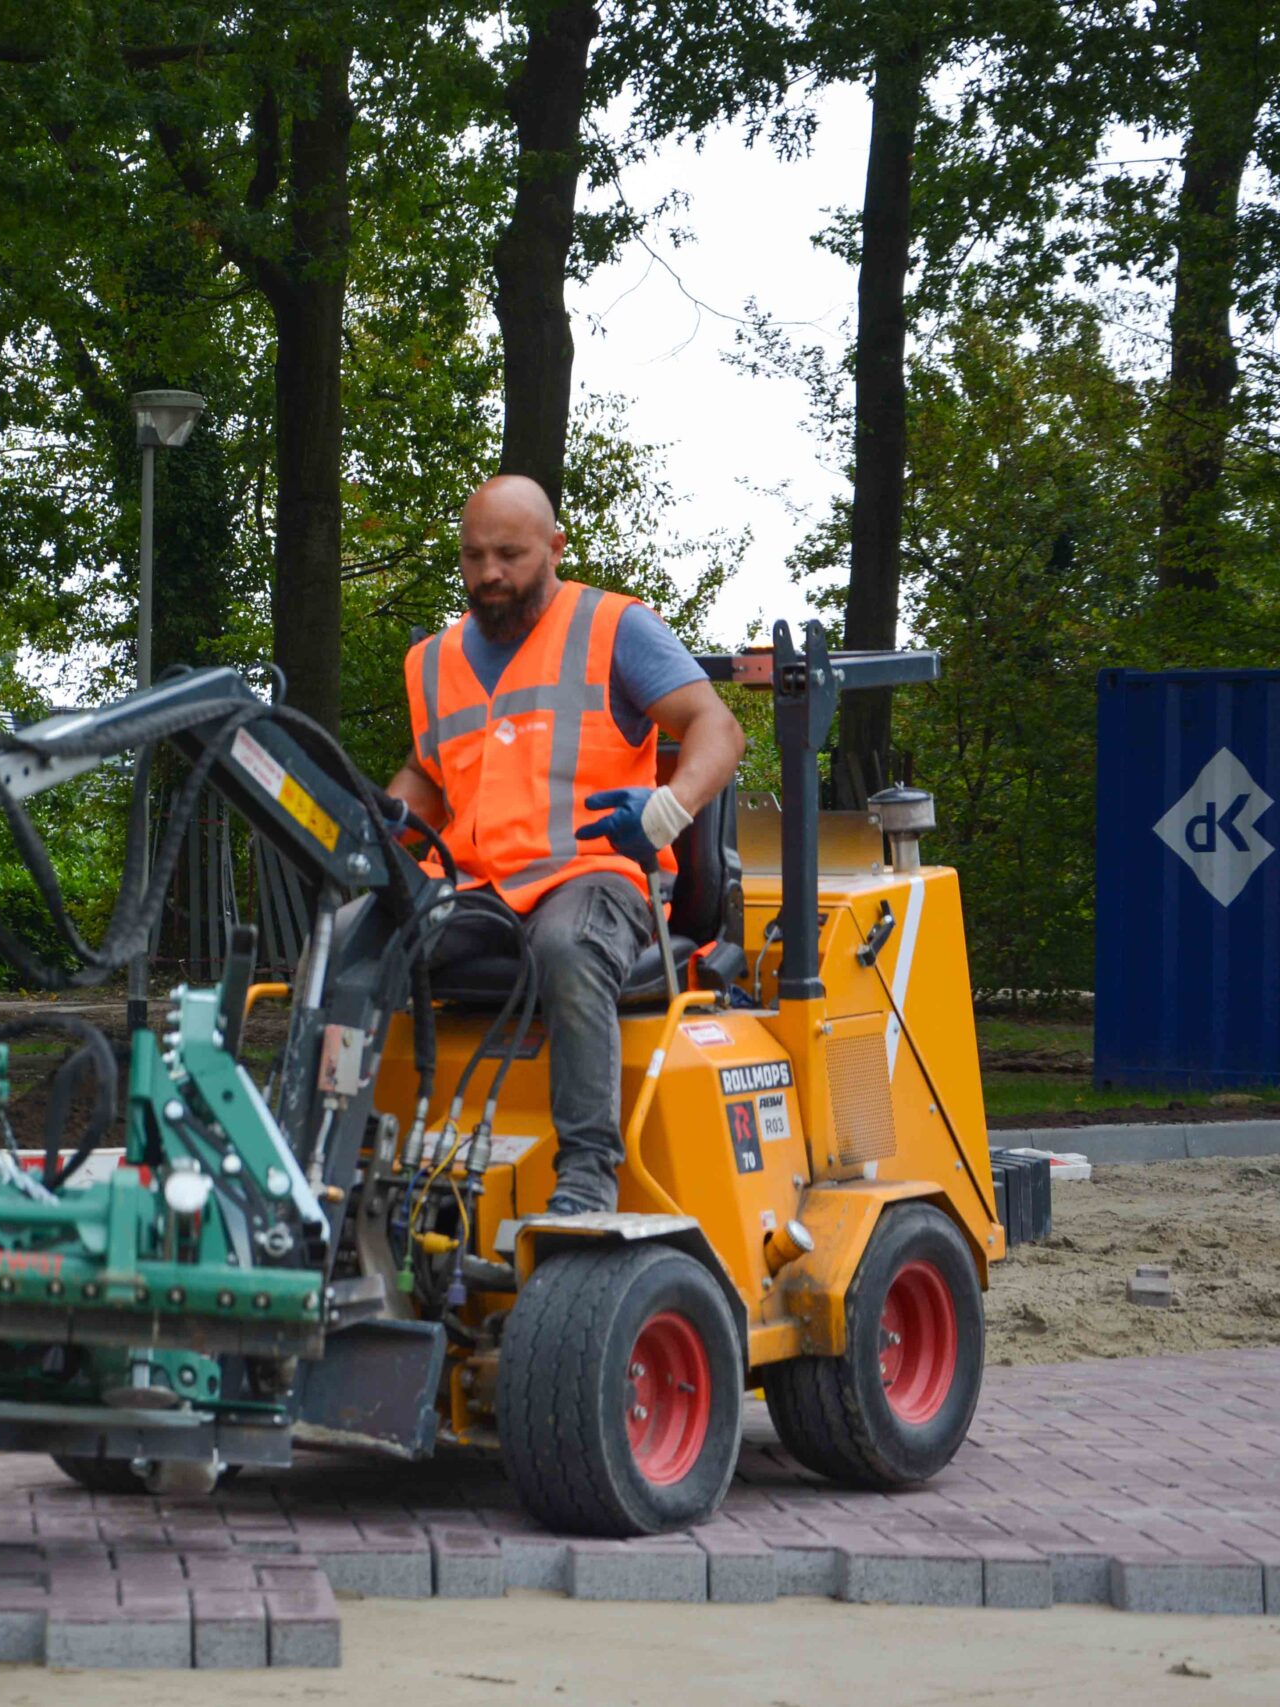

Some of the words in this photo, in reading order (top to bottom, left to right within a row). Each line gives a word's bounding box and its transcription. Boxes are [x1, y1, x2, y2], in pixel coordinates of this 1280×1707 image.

[722, 1063, 790, 1092] ROLLMOPS
[765, 1117, 784, 1134] R03
[742, 1151, 756, 1169] 70
